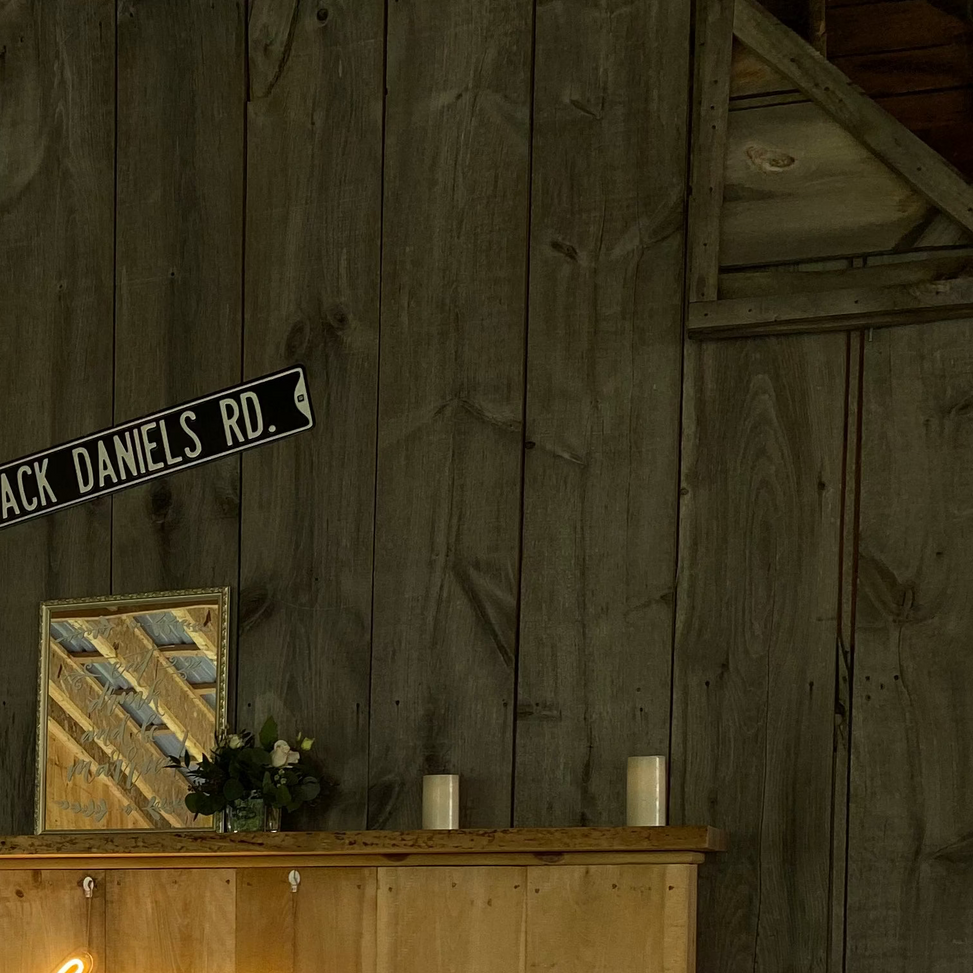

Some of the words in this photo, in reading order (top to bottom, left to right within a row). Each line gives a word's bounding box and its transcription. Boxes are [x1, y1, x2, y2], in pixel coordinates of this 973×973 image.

[72, 410, 202, 494] DANIELS
[219, 391, 277, 447] RD.
[88, 678, 165, 717] drink
[81, 713, 131, 747] and
[136, 713, 159, 744] be
